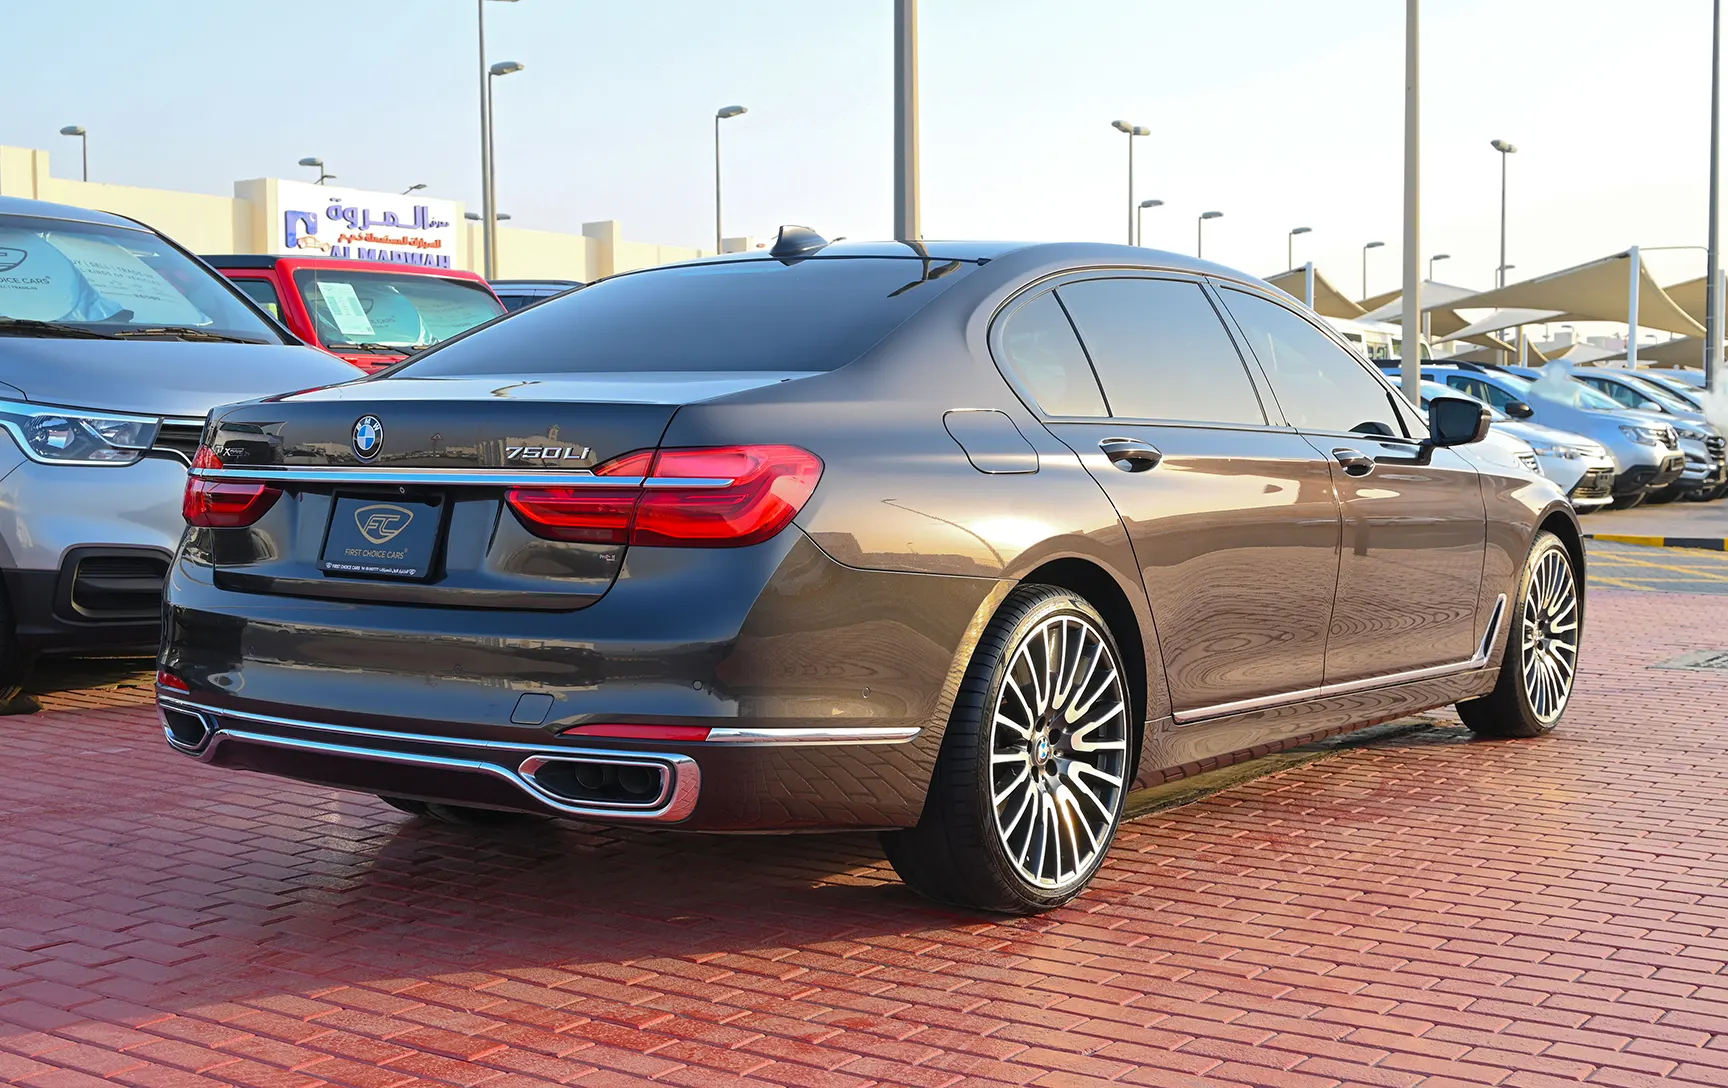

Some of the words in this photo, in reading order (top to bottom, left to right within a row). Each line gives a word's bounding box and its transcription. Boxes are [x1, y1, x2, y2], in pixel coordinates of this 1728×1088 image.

[326, 197, 429, 231] المروة
[344, 548, 362, 557] FIRST
[362, 549, 386, 558] CHOICE
[386, 550, 404, 559] CARS
